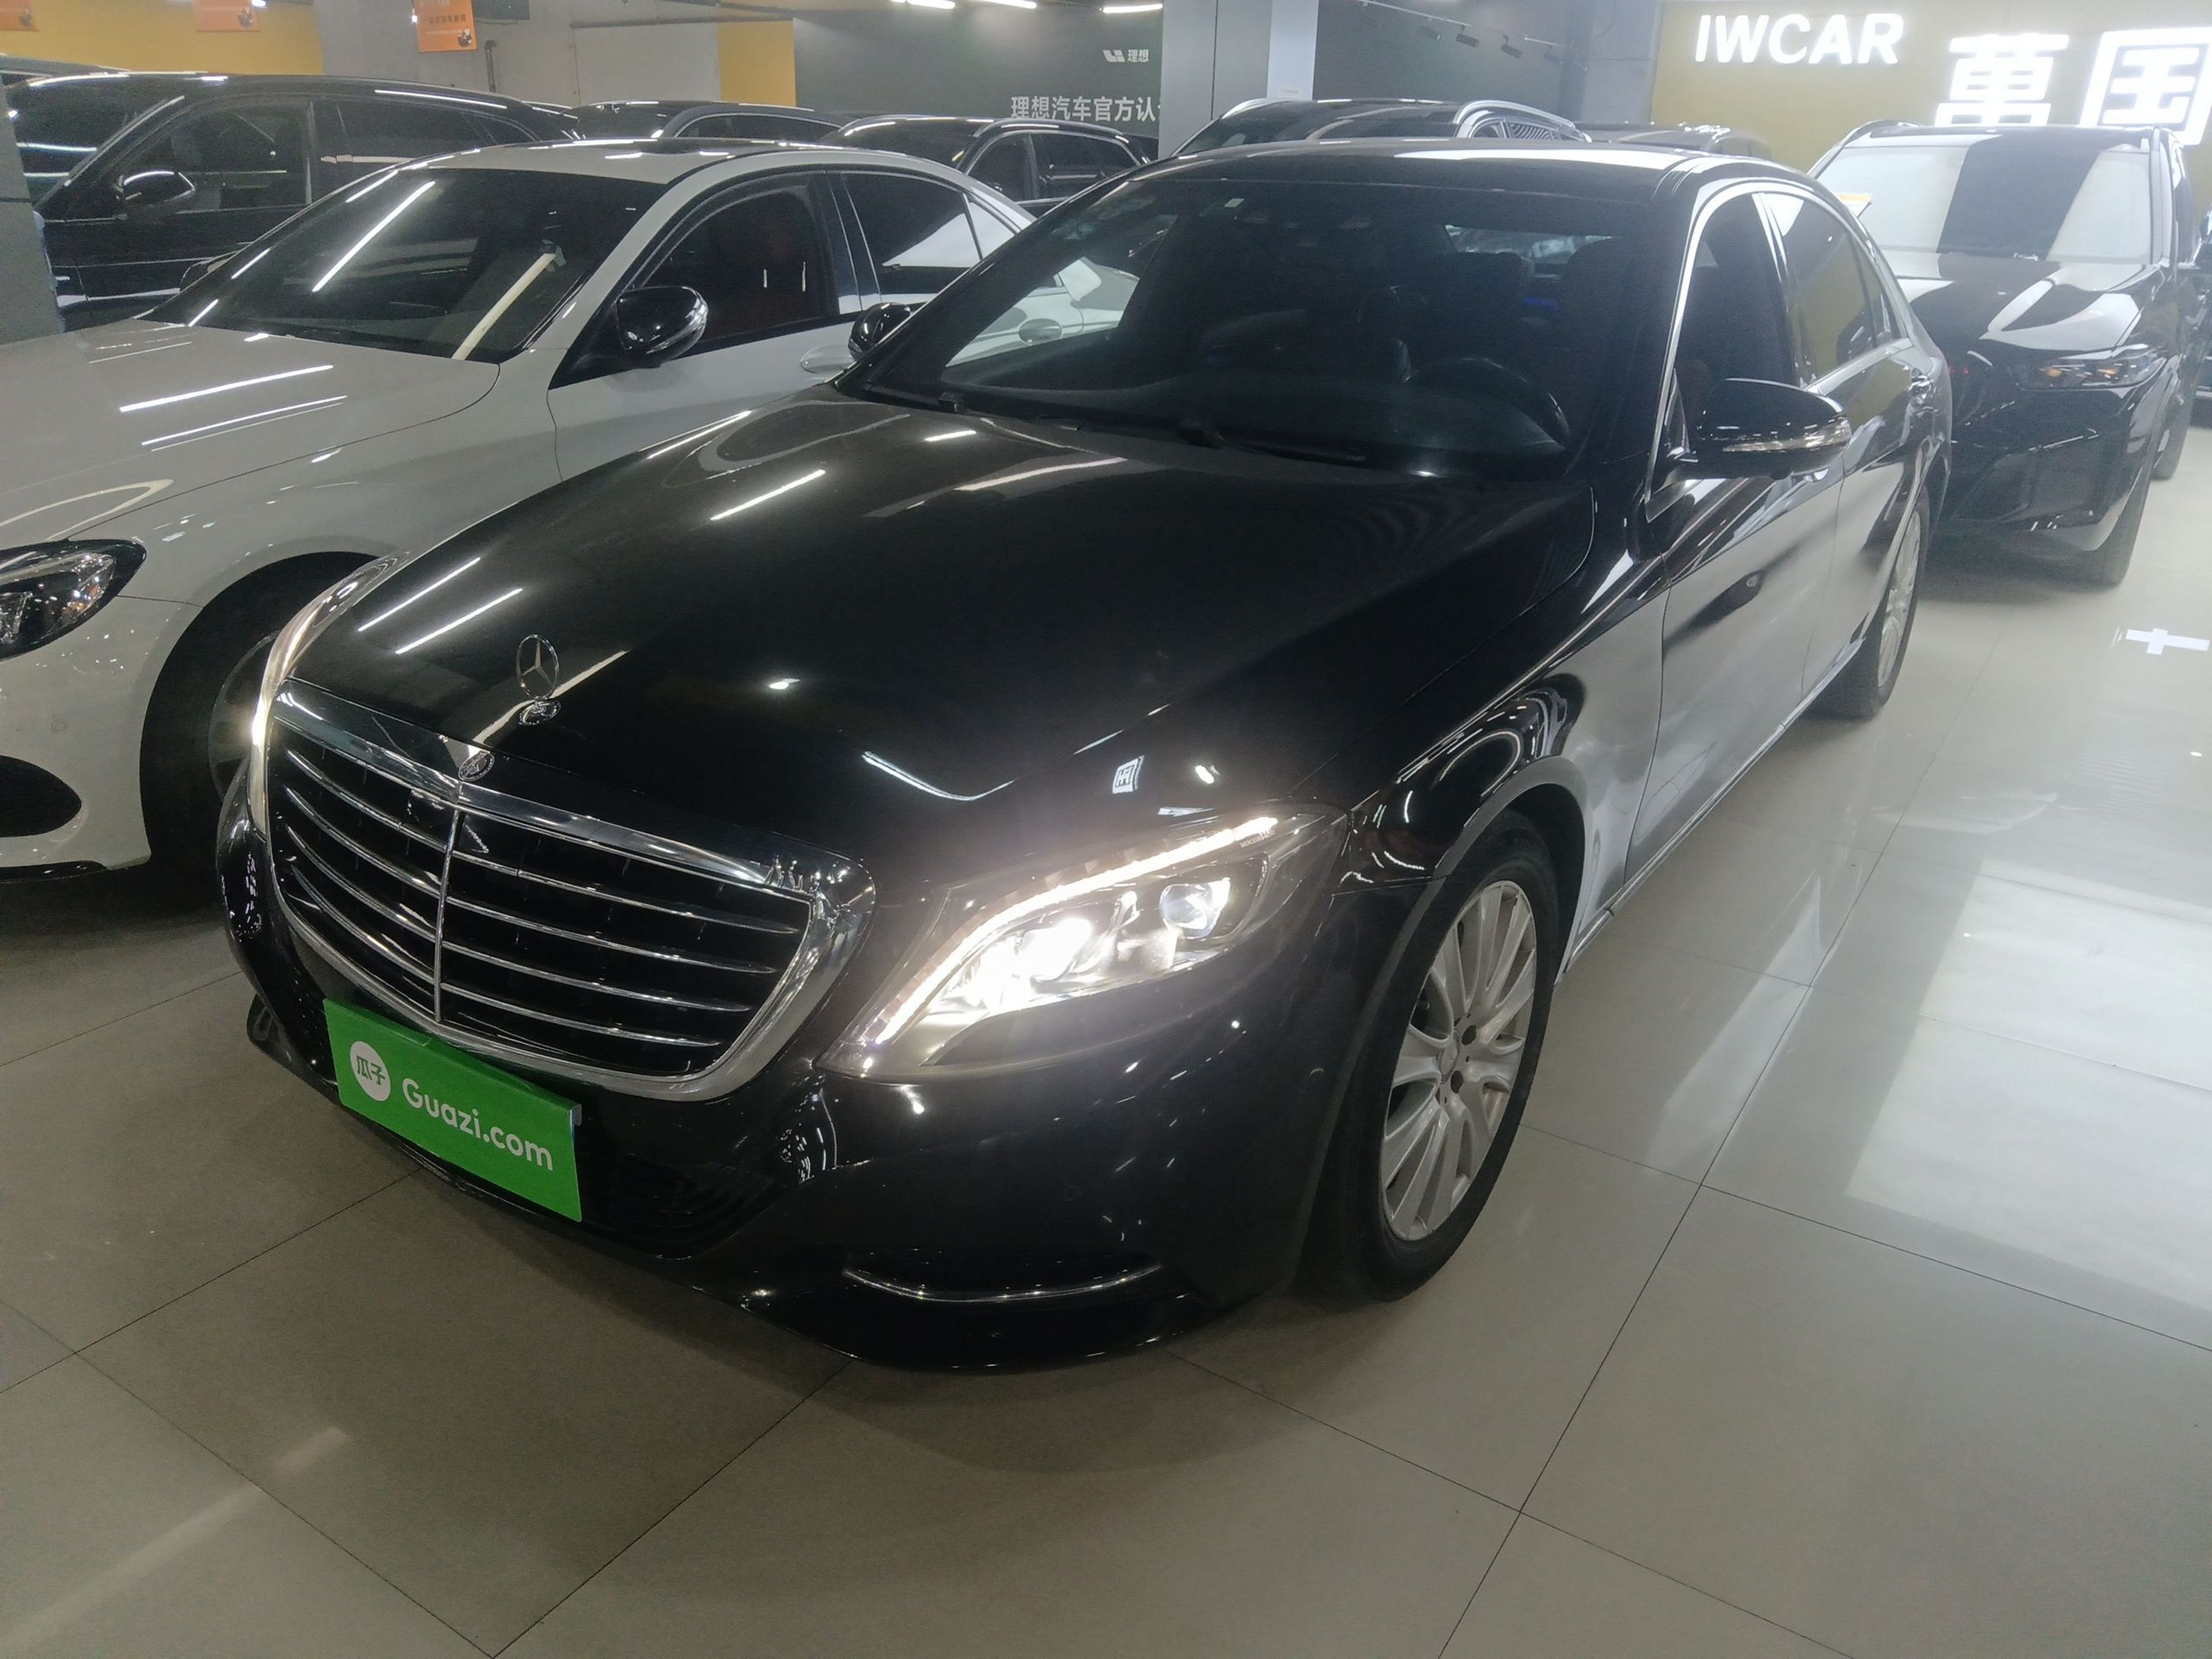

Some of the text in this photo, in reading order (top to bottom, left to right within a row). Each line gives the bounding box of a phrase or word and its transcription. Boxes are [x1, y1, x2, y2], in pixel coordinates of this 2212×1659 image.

[1695, 13, 1904, 65] IWCAR
[1127, 48, 1149, 62] 理想
[1011, 96, 1161, 122] 理想汽车官方认
[356, 1055, 385, 1085] 瓜子
[403, 1078, 553, 1171] Guazi.com
